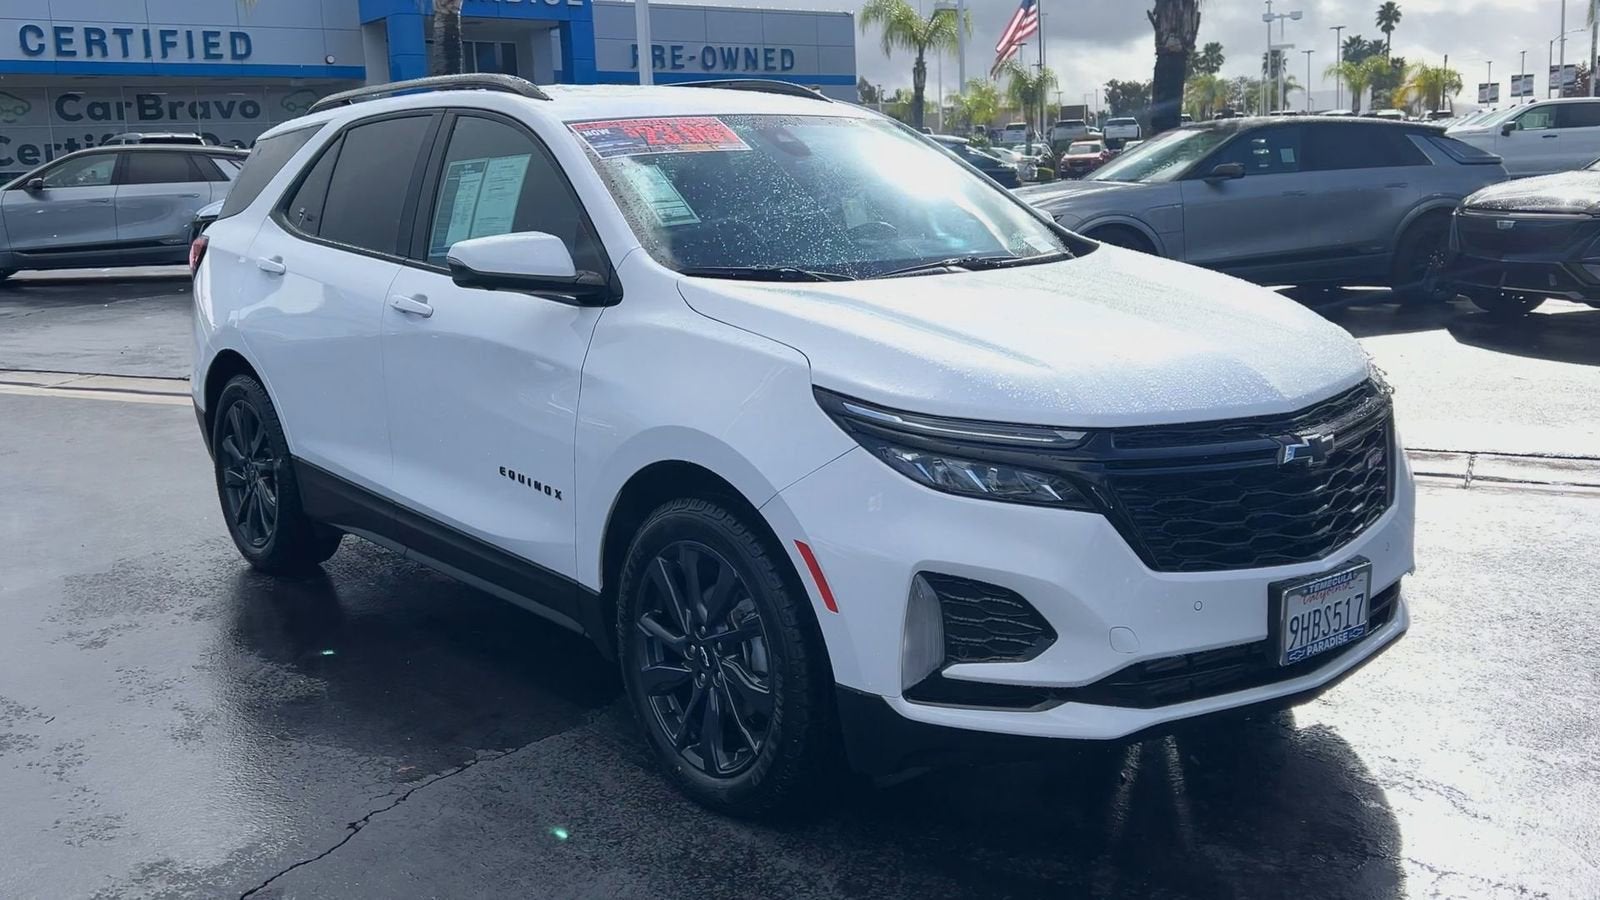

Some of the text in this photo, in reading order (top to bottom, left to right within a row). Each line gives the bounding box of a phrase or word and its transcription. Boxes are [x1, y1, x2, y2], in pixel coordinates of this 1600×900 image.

[19, 24, 252, 60] CERTIFIED
[55, 93, 261, 122] CarBravo
[499, 465, 562, 501] EQUINOX
[1308, 571, 1354, 593] TEMECULA
[1288, 593, 1364, 650] 9HBS517
[1306, 632, 1348, 656] PARADISE
